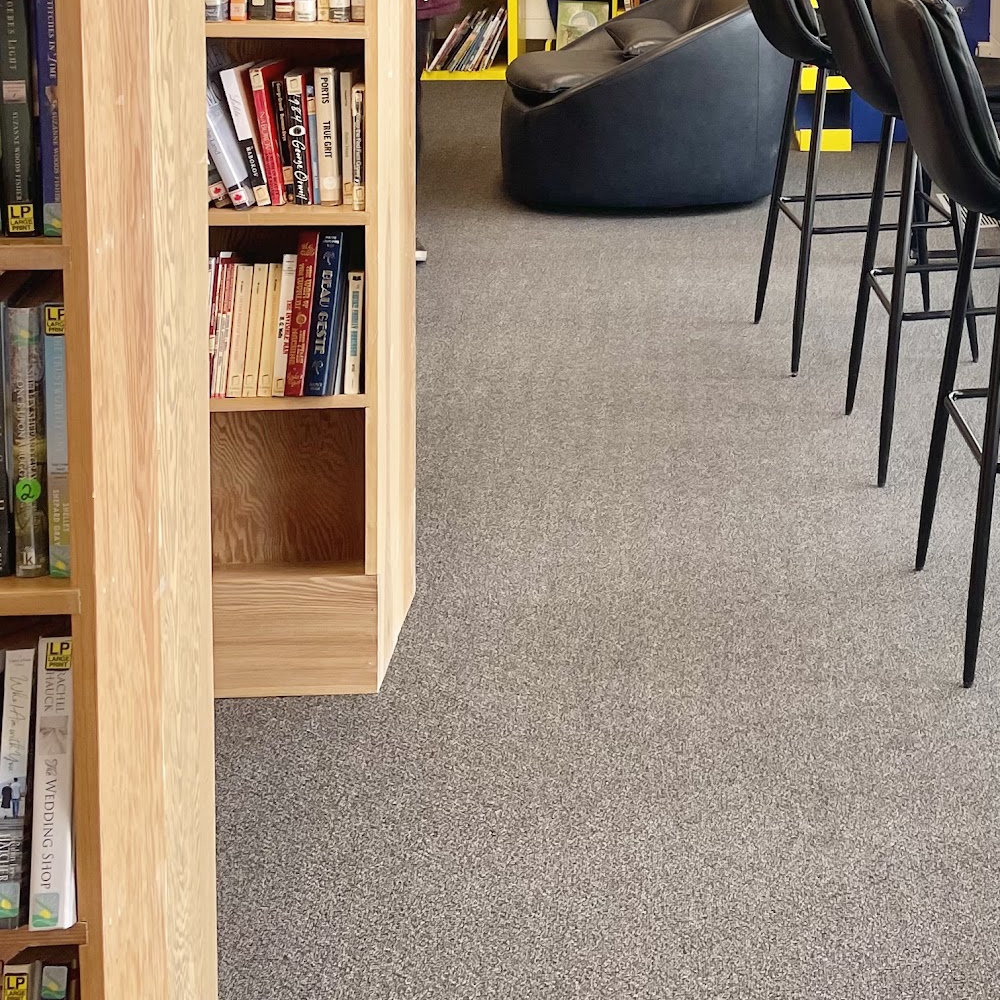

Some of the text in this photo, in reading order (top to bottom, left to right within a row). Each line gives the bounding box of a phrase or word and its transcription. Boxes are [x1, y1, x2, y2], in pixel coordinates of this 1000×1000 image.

[320, 77, 330, 104] PORTIS
[51, 111, 59, 146] SUZANNE
[259, 111, 272, 153] NABOKOV
[322, 120, 333, 158] TRUE GRIT
[12, 111, 23, 201] SUZANNE WOODS FISHER
[245, 147, 259, 178] NABOKOV
[291, 139, 308, 201] George Orwell
[10, 205, 31, 219] LP
[314, 269, 334, 355] BEAU GESTE
[16, 380, 26, 409] ONCE
[17, 410, 26, 438] UPON
[20, 484, 35, 501] 2
[52, 489, 61, 547] SHEPARD GRAY
[62, 503, 70, 532] SHELLEY
[49, 642, 70, 655] LP
[44, 671, 55, 713] HAUCK
[40, 758, 58, 890] The WEDDING SHOP
[7, 976, 26, 990] LP
